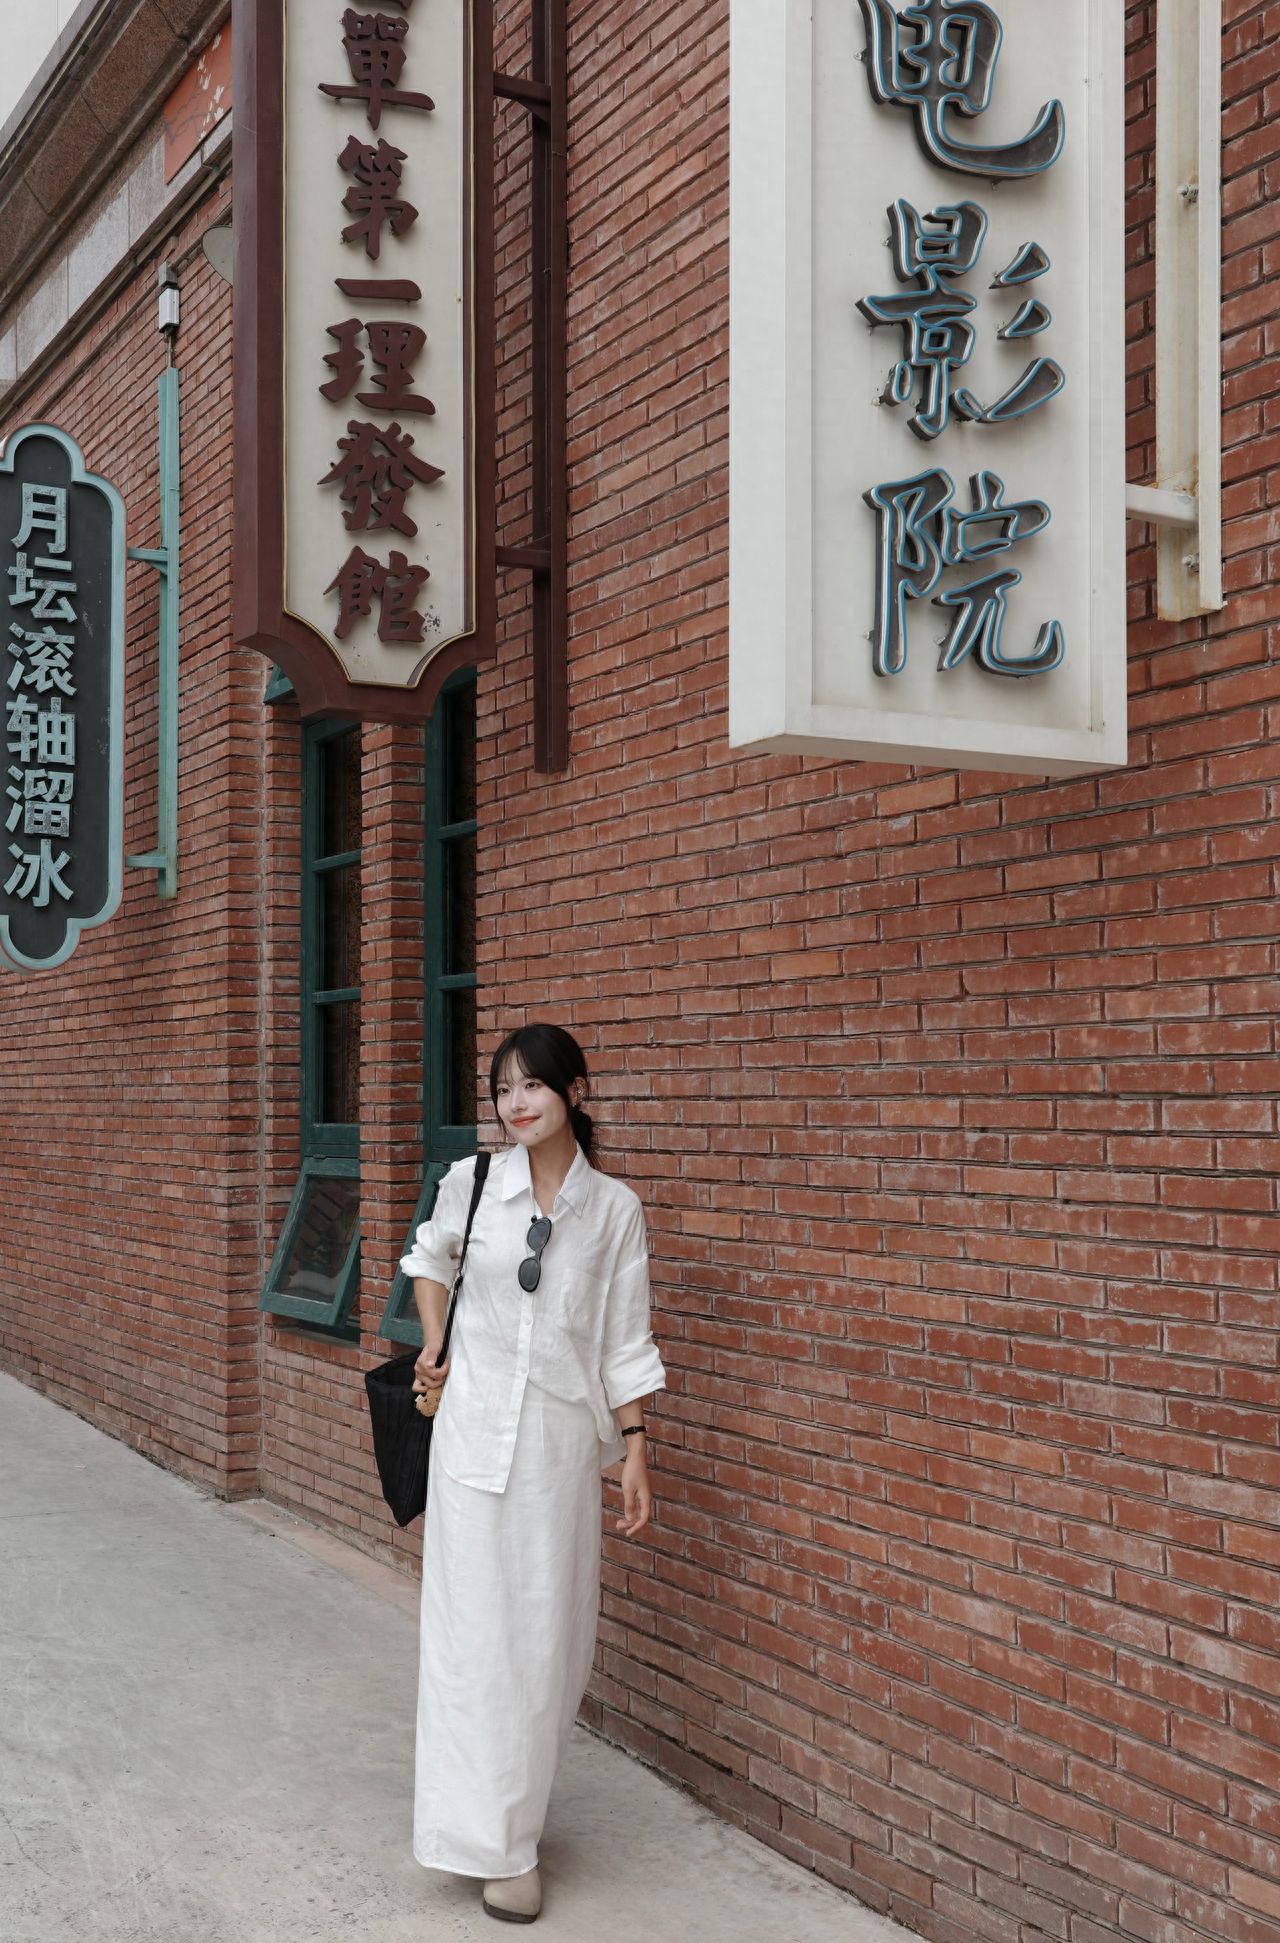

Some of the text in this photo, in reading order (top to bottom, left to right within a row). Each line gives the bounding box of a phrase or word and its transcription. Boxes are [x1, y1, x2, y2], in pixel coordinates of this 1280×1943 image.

[317, 0, 446, 642] 單第一理發館
[4, 482, 78, 907] 月坛滚轴溜冰
